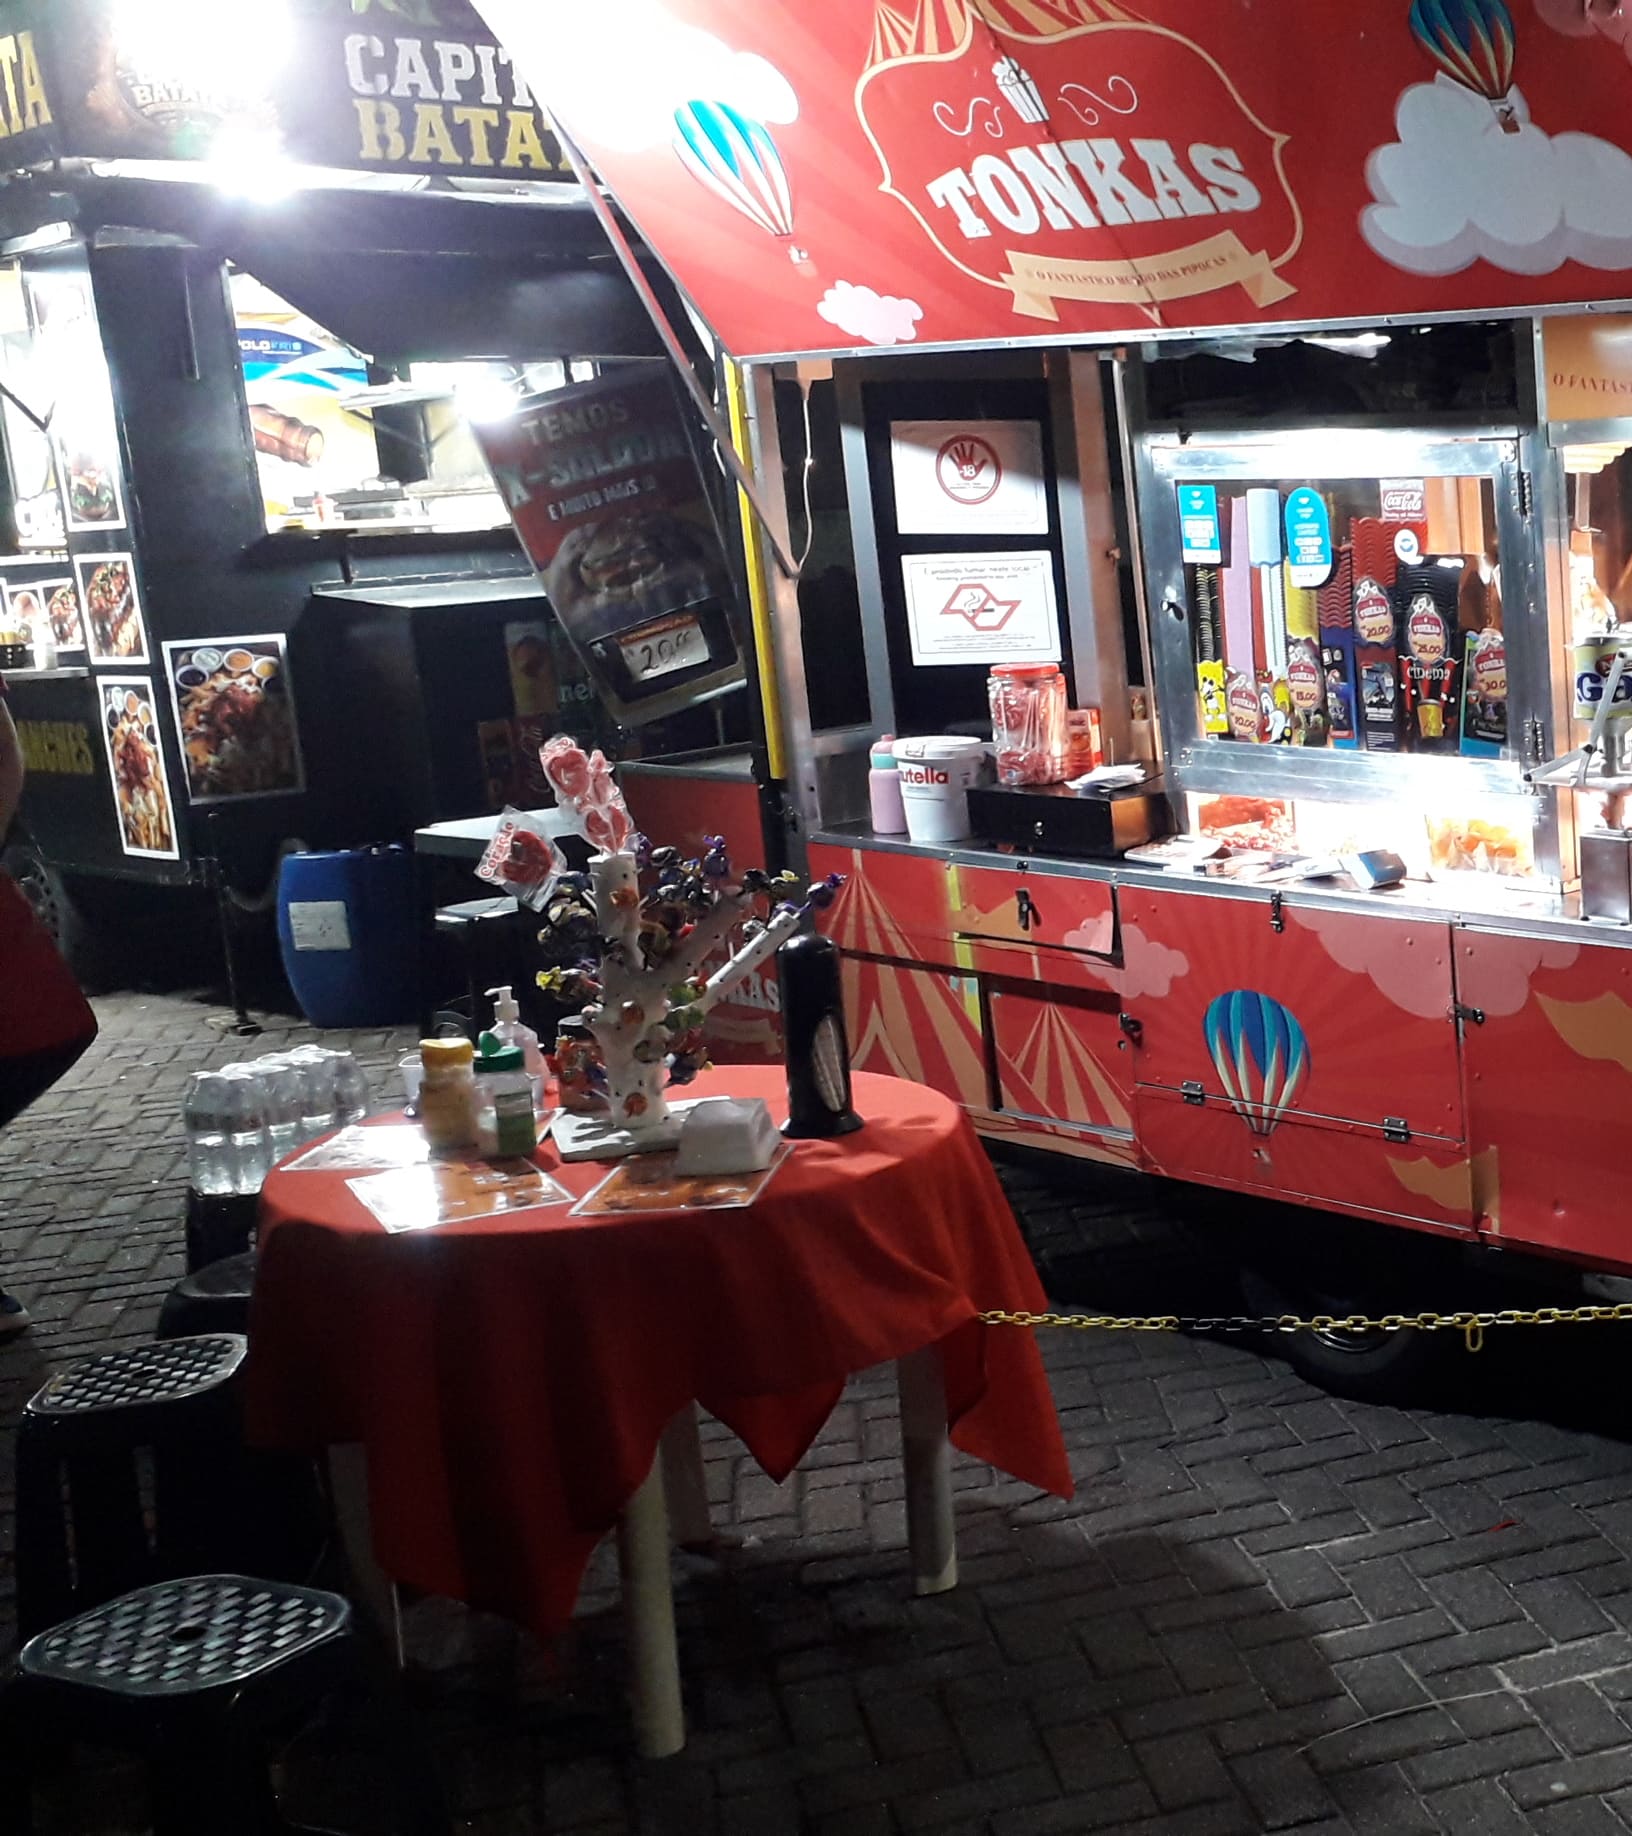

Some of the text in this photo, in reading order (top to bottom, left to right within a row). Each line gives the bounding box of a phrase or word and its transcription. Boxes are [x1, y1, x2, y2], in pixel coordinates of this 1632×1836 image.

[344, 33, 534, 107] CAPIT
[352, 97, 572, 170] BATA
[925, 137, 1262, 239] TONKAS
